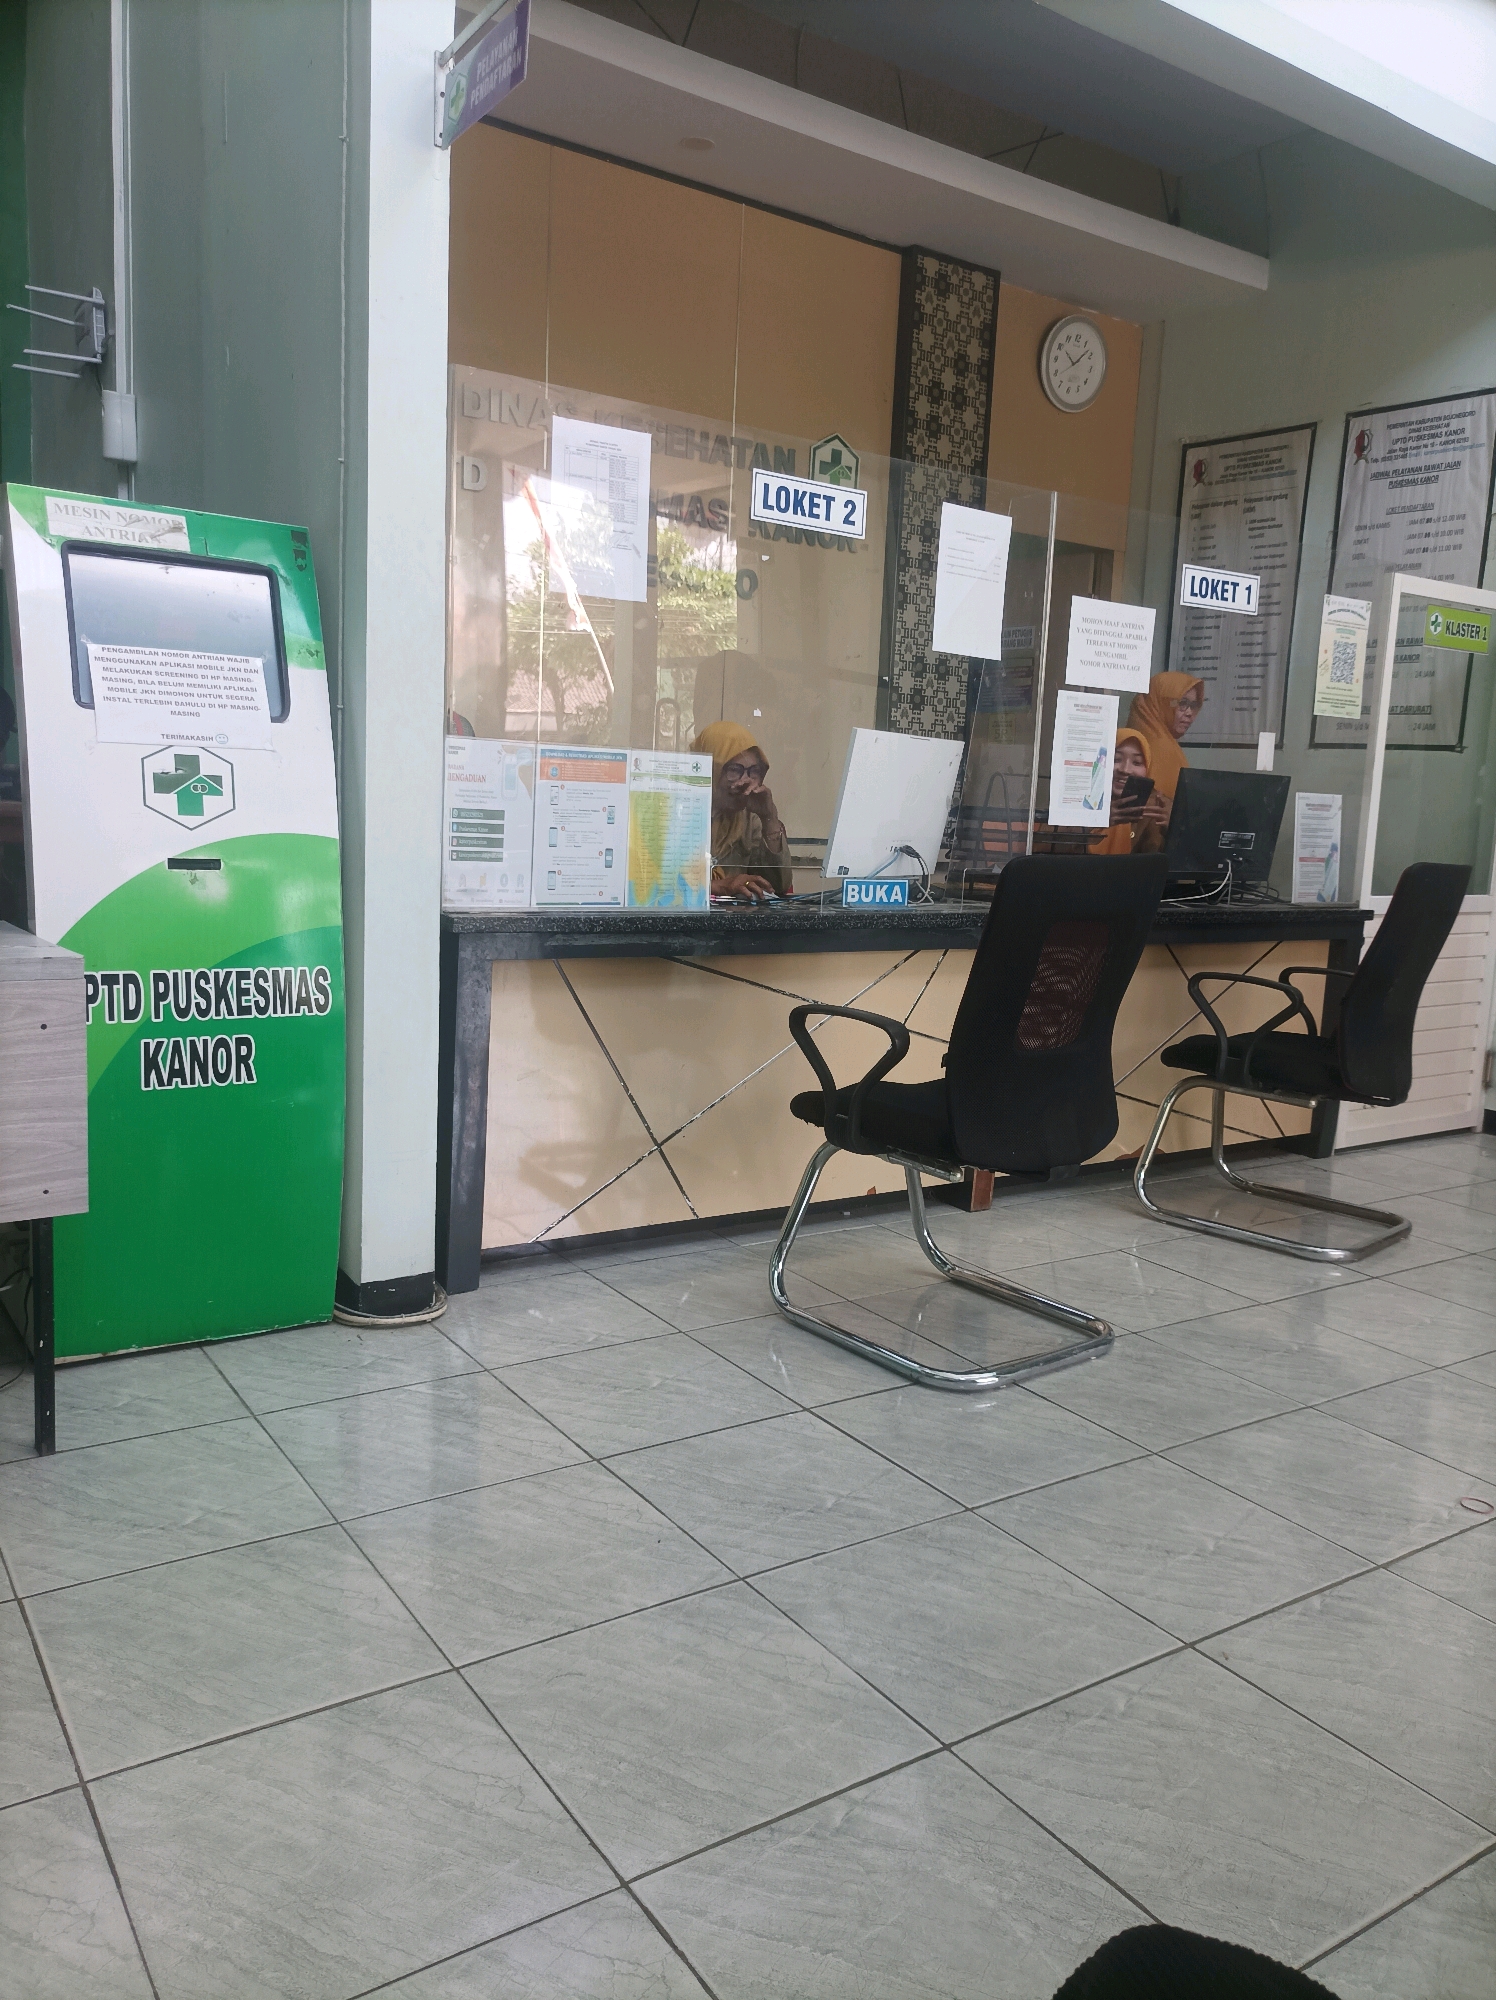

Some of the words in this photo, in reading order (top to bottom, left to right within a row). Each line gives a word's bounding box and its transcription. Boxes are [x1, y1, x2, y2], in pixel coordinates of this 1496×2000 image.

[1075, 334, 1081, 342] 12
[1088, 352, 1093, 360] 2
[1053, 369, 1058, 377] 8
[1392, 437, 1407, 445] UPTD
[1408, 432, 1443, 443] PUSKESMAS
[1444, 428, 1465, 437] KANOR
[1392, 466, 1422, 476] PELAYANAN
[1424, 463, 1444, 471] RAWAT
[1388, 478, 1419, 488] PUSKESMAS
[1420, 475, 1439, 484] KANOR
[762, 482, 835, 522] LOKET
[843, 500, 856, 526] 2
[1401, 503, 1434, 512] PENDAFTARAN
[54, 503, 110, 520] MESIN
[1190, 576, 1239, 602] LOKET
[1245, 584, 1252, 605] 1
[1082, 617, 1103, 625] MOHON
[1121, 622, 1145, 630] ANTRIAN
[1094, 630, 1123, 638] DITINGGAL
[1445, 621, 1480, 640] KLASTER
[1482, 626, 1487, 640] 1
[1086, 639, 1115, 648] TERLEWAT
[101, 647, 159, 656] PENGAMBILAN
[192, 653, 225, 662] ANTRIAN
[1095, 651, 1128, 660] MENGAMBIL
[94, 656, 157, 666] MENGGUNAKAN
[159, 661, 194, 669] APLIKASI
[102, 666, 152, 676] MELAKUKAN
[154, 670, 199, 679] SCREENING
[102, 676, 136, 685] MASING,
[187, 682, 221, 691] MEMILIKI
[108, 686, 137, 694] MOBILE
[158, 690, 195, 698] DIMOHON
[103, 695, 132, 704] INSTAL
[161, 734, 213, 742] TERIMAKASIH
[847, 885, 903, 902] BUKA
[84, 971, 144, 1024] PTD
[150, 966, 332, 1022] PUSKESMAS
[140, 1034, 257, 1091] KANOR
